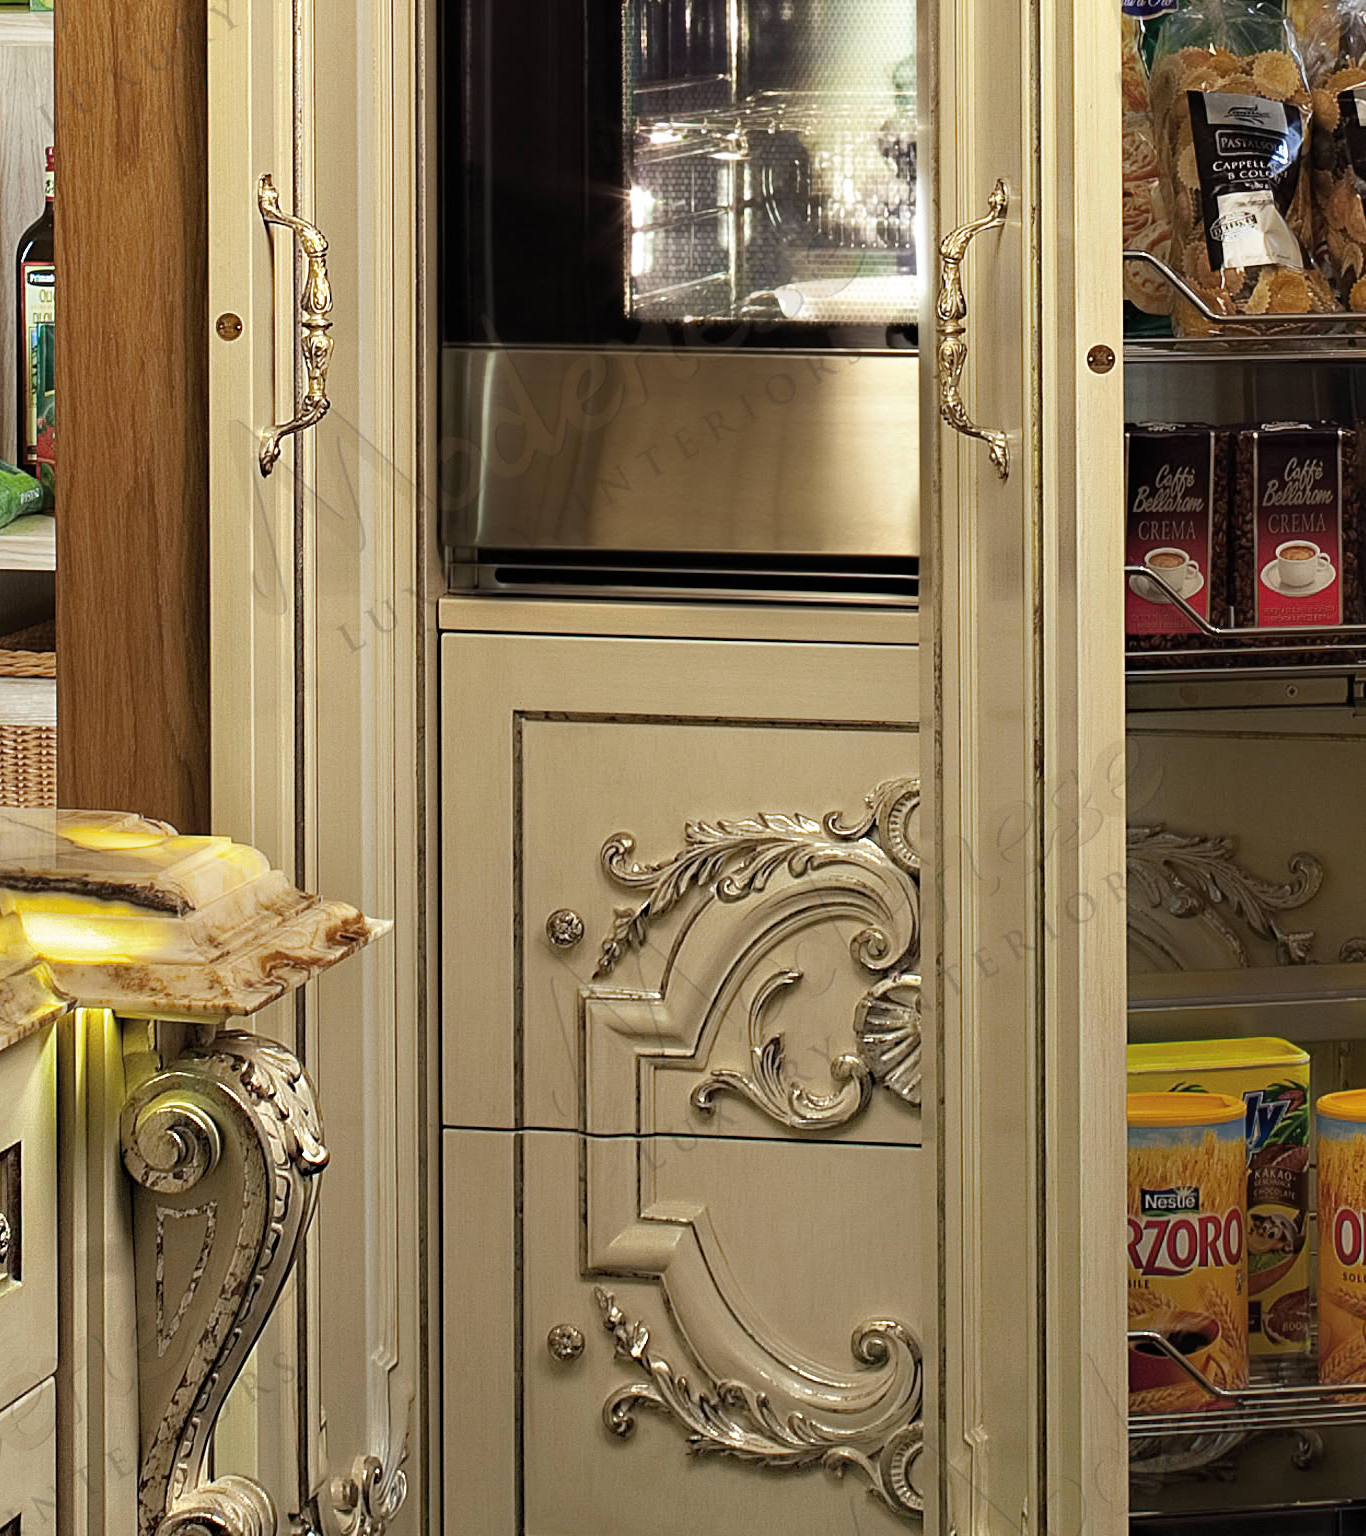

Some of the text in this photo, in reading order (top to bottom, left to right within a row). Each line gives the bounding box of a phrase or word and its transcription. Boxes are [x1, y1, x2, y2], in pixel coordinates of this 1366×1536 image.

[1155, 464, 1196, 496] Caffè
[1284, 457, 1324, 489] Caffè
[1138, 520, 1196, 541] CREMA
[1267, 513, 1327, 534] CREMA
[1127, 1208, 1243, 1277] RZORO
